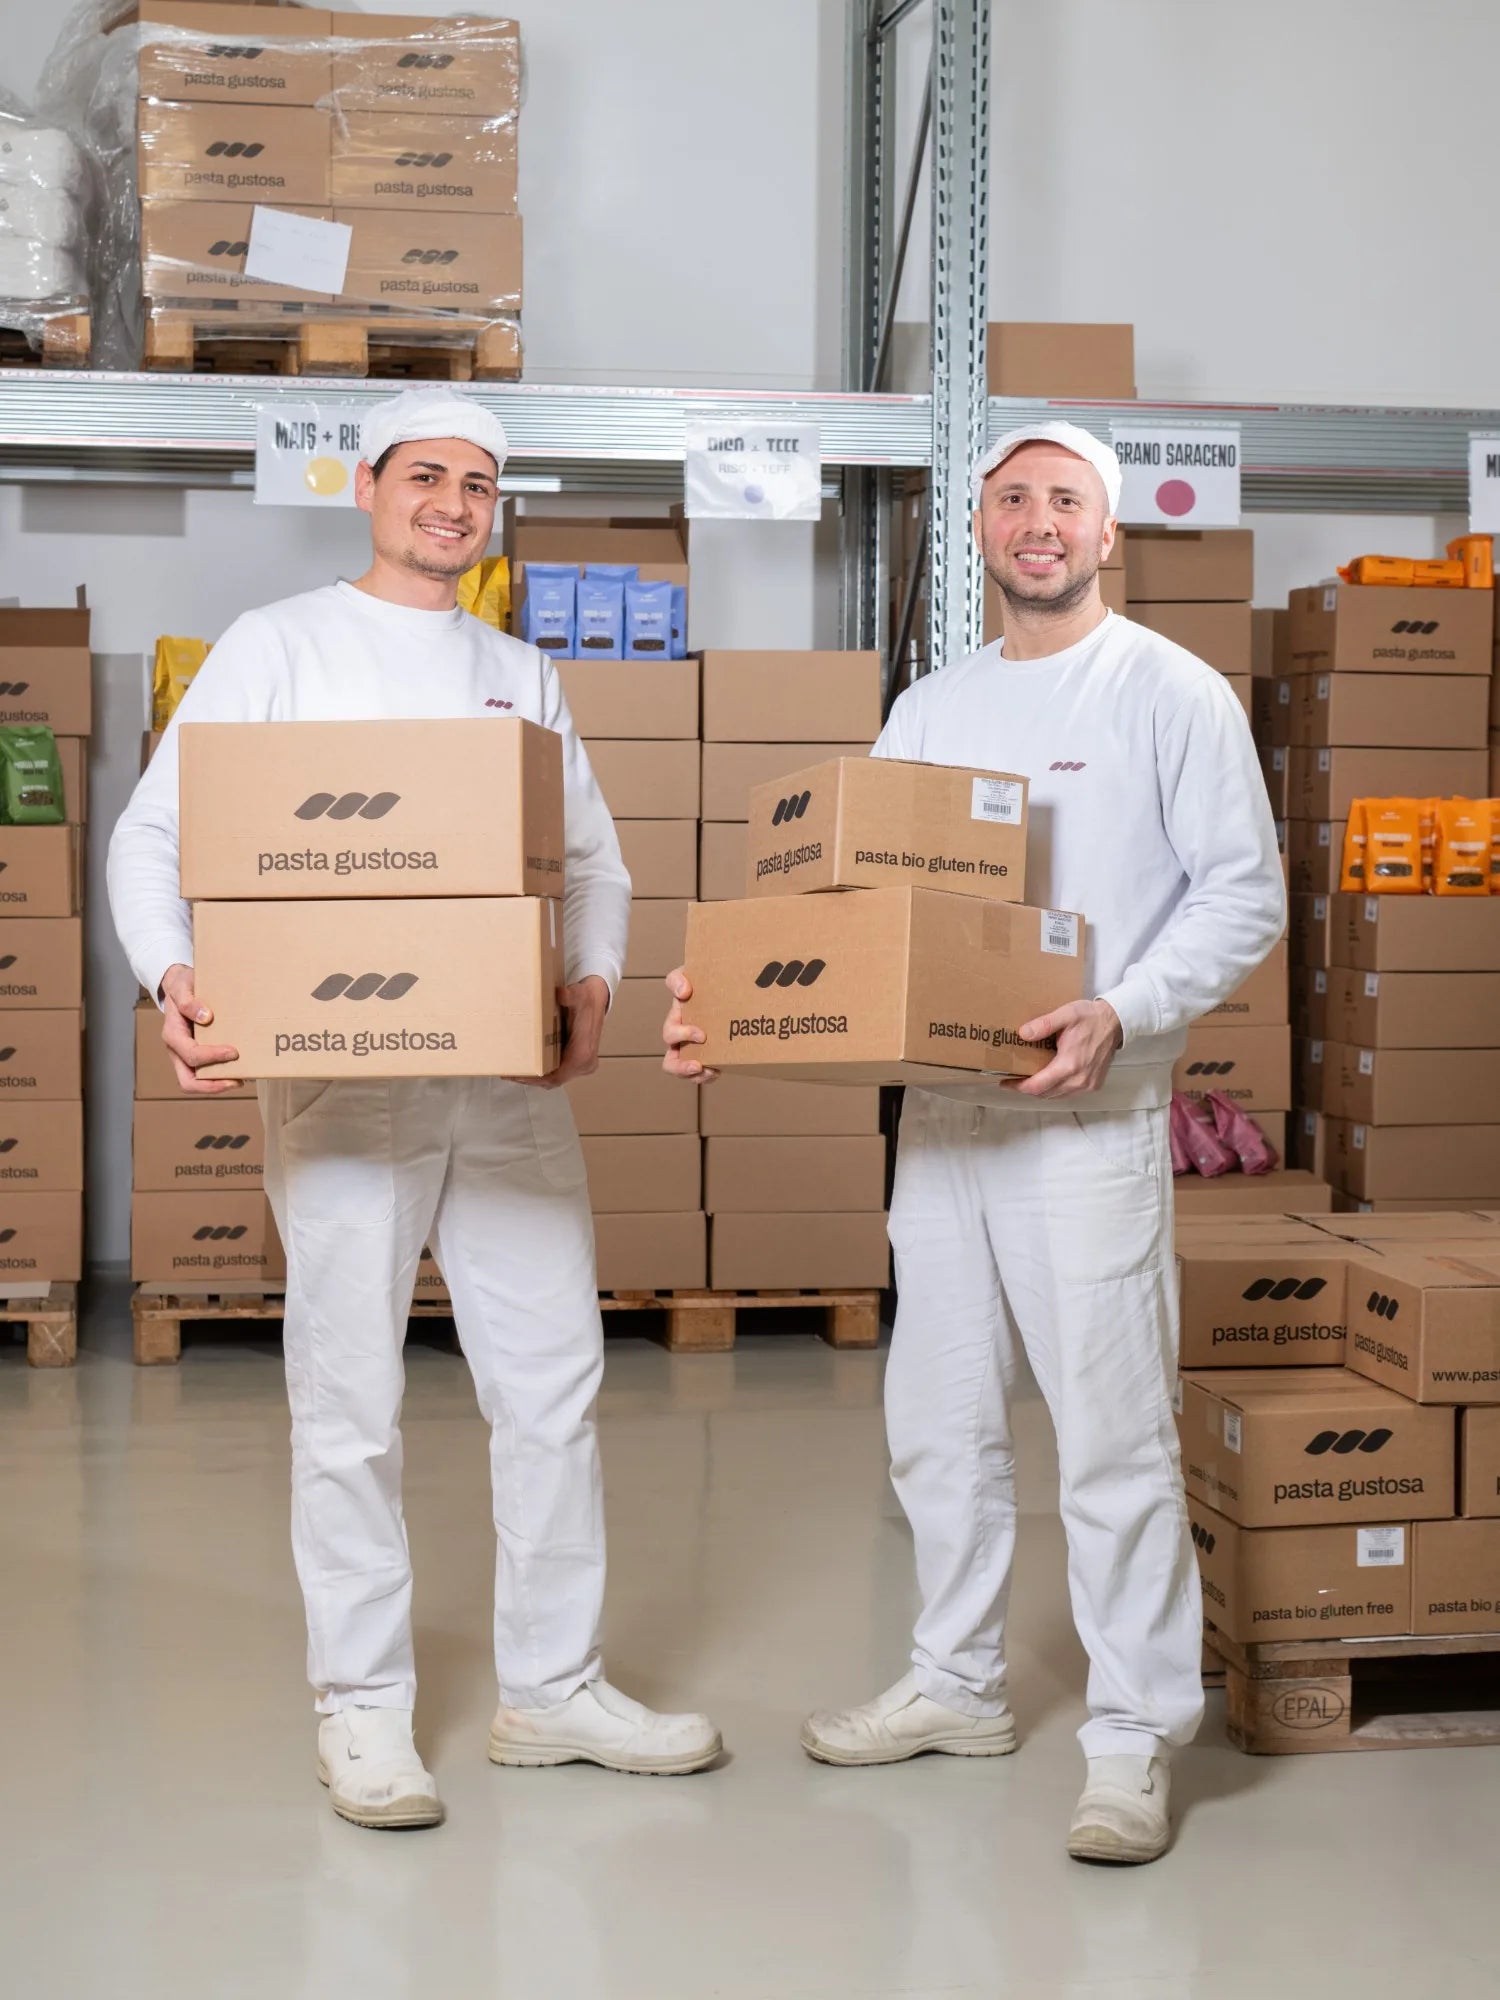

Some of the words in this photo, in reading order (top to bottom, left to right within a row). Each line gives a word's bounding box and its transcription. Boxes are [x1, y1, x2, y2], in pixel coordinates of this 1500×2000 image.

[184, 72, 226, 87] pasta
[228, 73, 286, 89] gustosa
[184, 172, 226, 187] pasta
[228, 173, 285, 189] gustosa
[374, 181, 414, 195] pasta
[416, 182, 473, 197] gustosa
[380, 278, 420, 293] pasta
[422, 280, 479, 295] gustosa
[275, 422, 317, 451] MAIS
[323, 431, 334, 443] +
[1115, 441, 1160, 466] GRANO
[1166, 443, 1236, 468] SARACENO
[1372, 646, 1406, 660] pasta
[1407, 648, 1456, 662] gustosa
[258, 849, 330, 876] pasta
[335, 848, 438, 876] gustosa
[756, 855, 782, 881] pasta
[783, 842, 822, 874] gustosa
[855, 850, 899, 866] pasta
[902, 852, 925, 868] bio
[928, 856, 975, 873] gluten
[978, 860, 1008, 877] free
[729, 1015, 776, 1041] pasta
[778, 1013, 848, 1040] gustosa
[928, 1021, 967, 1040] pasta
[970, 1024, 990, 1042] bio
[275, 1029, 347, 1057] pasta
[352, 1028, 457, 1057] gustosa
[175, 1164, 213, 1178] pasta
[172, 1254, 211, 1269] pasta
[213, 1253, 267, 1270] gustosa
[1212, 1324, 1270, 1346] pasta
[1354, 1331, 1376, 1353] pasta
[1376, 1343, 1409, 1371] gustosa
[1432, 1370, 1500, 1384] www.pas
[1274, 1479, 1334, 1504] pasta
[1338, 1476, 1424, 1501] gustosa
[1253, 1605, 1292, 1623] pasta
[1296, 1606, 1317, 1619] bio
[1320, 1603, 1363, 1620] gluten
[1366, 1602, 1394, 1616] free
[1428, 1600, 1467, 1616] pasta
[1471, 1599, 1492, 1611] bio
[1283, 1696, 1334, 1721] EPAL
